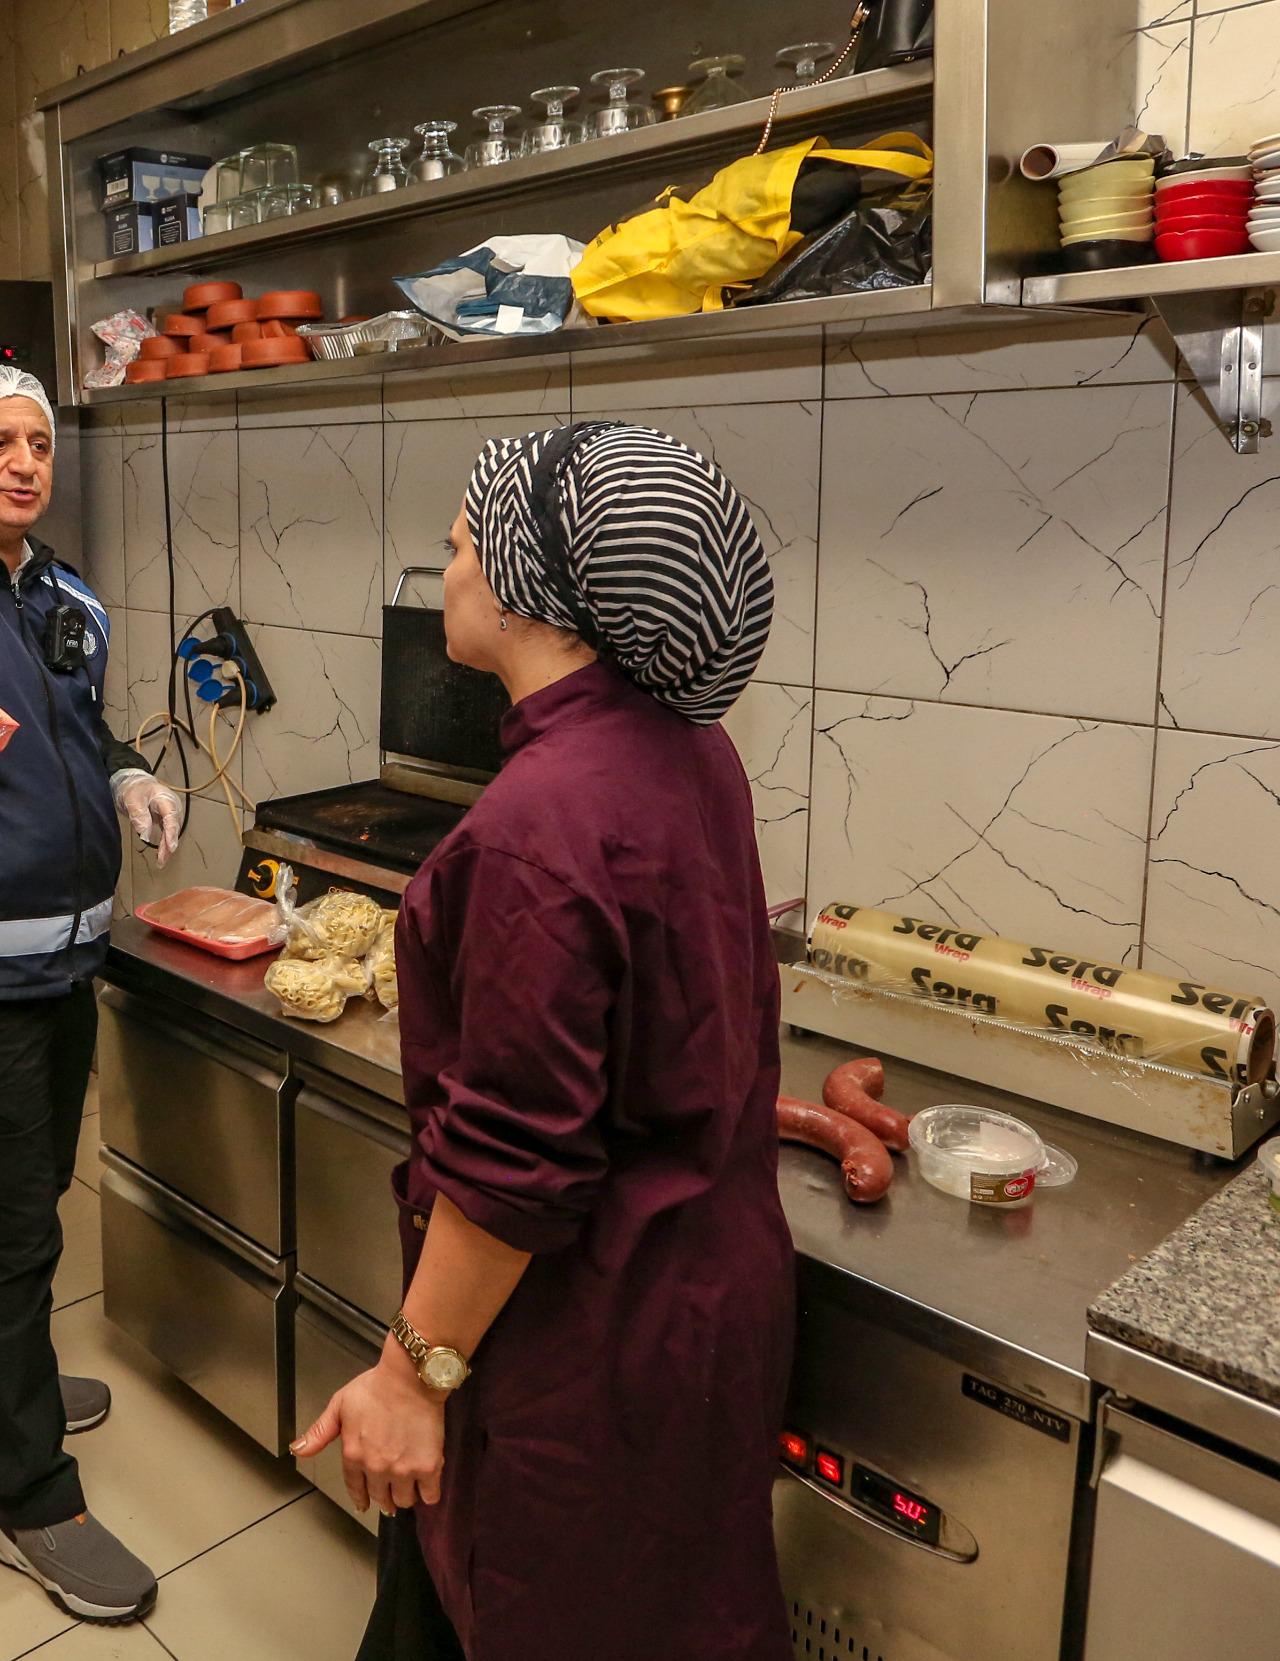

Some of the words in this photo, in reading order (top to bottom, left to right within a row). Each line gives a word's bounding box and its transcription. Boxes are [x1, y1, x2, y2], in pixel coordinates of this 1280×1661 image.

[893, 917, 982, 951] Sera
[812, 948, 869, 979] era
[934, 943, 970, 962] Wrap
[1022, 947, 1124, 987] Sera
[1071, 977, 1112, 999] Wrap
[1171, 983, 1251, 1018] Ser
[970, 1380, 997, 1400] TAG
